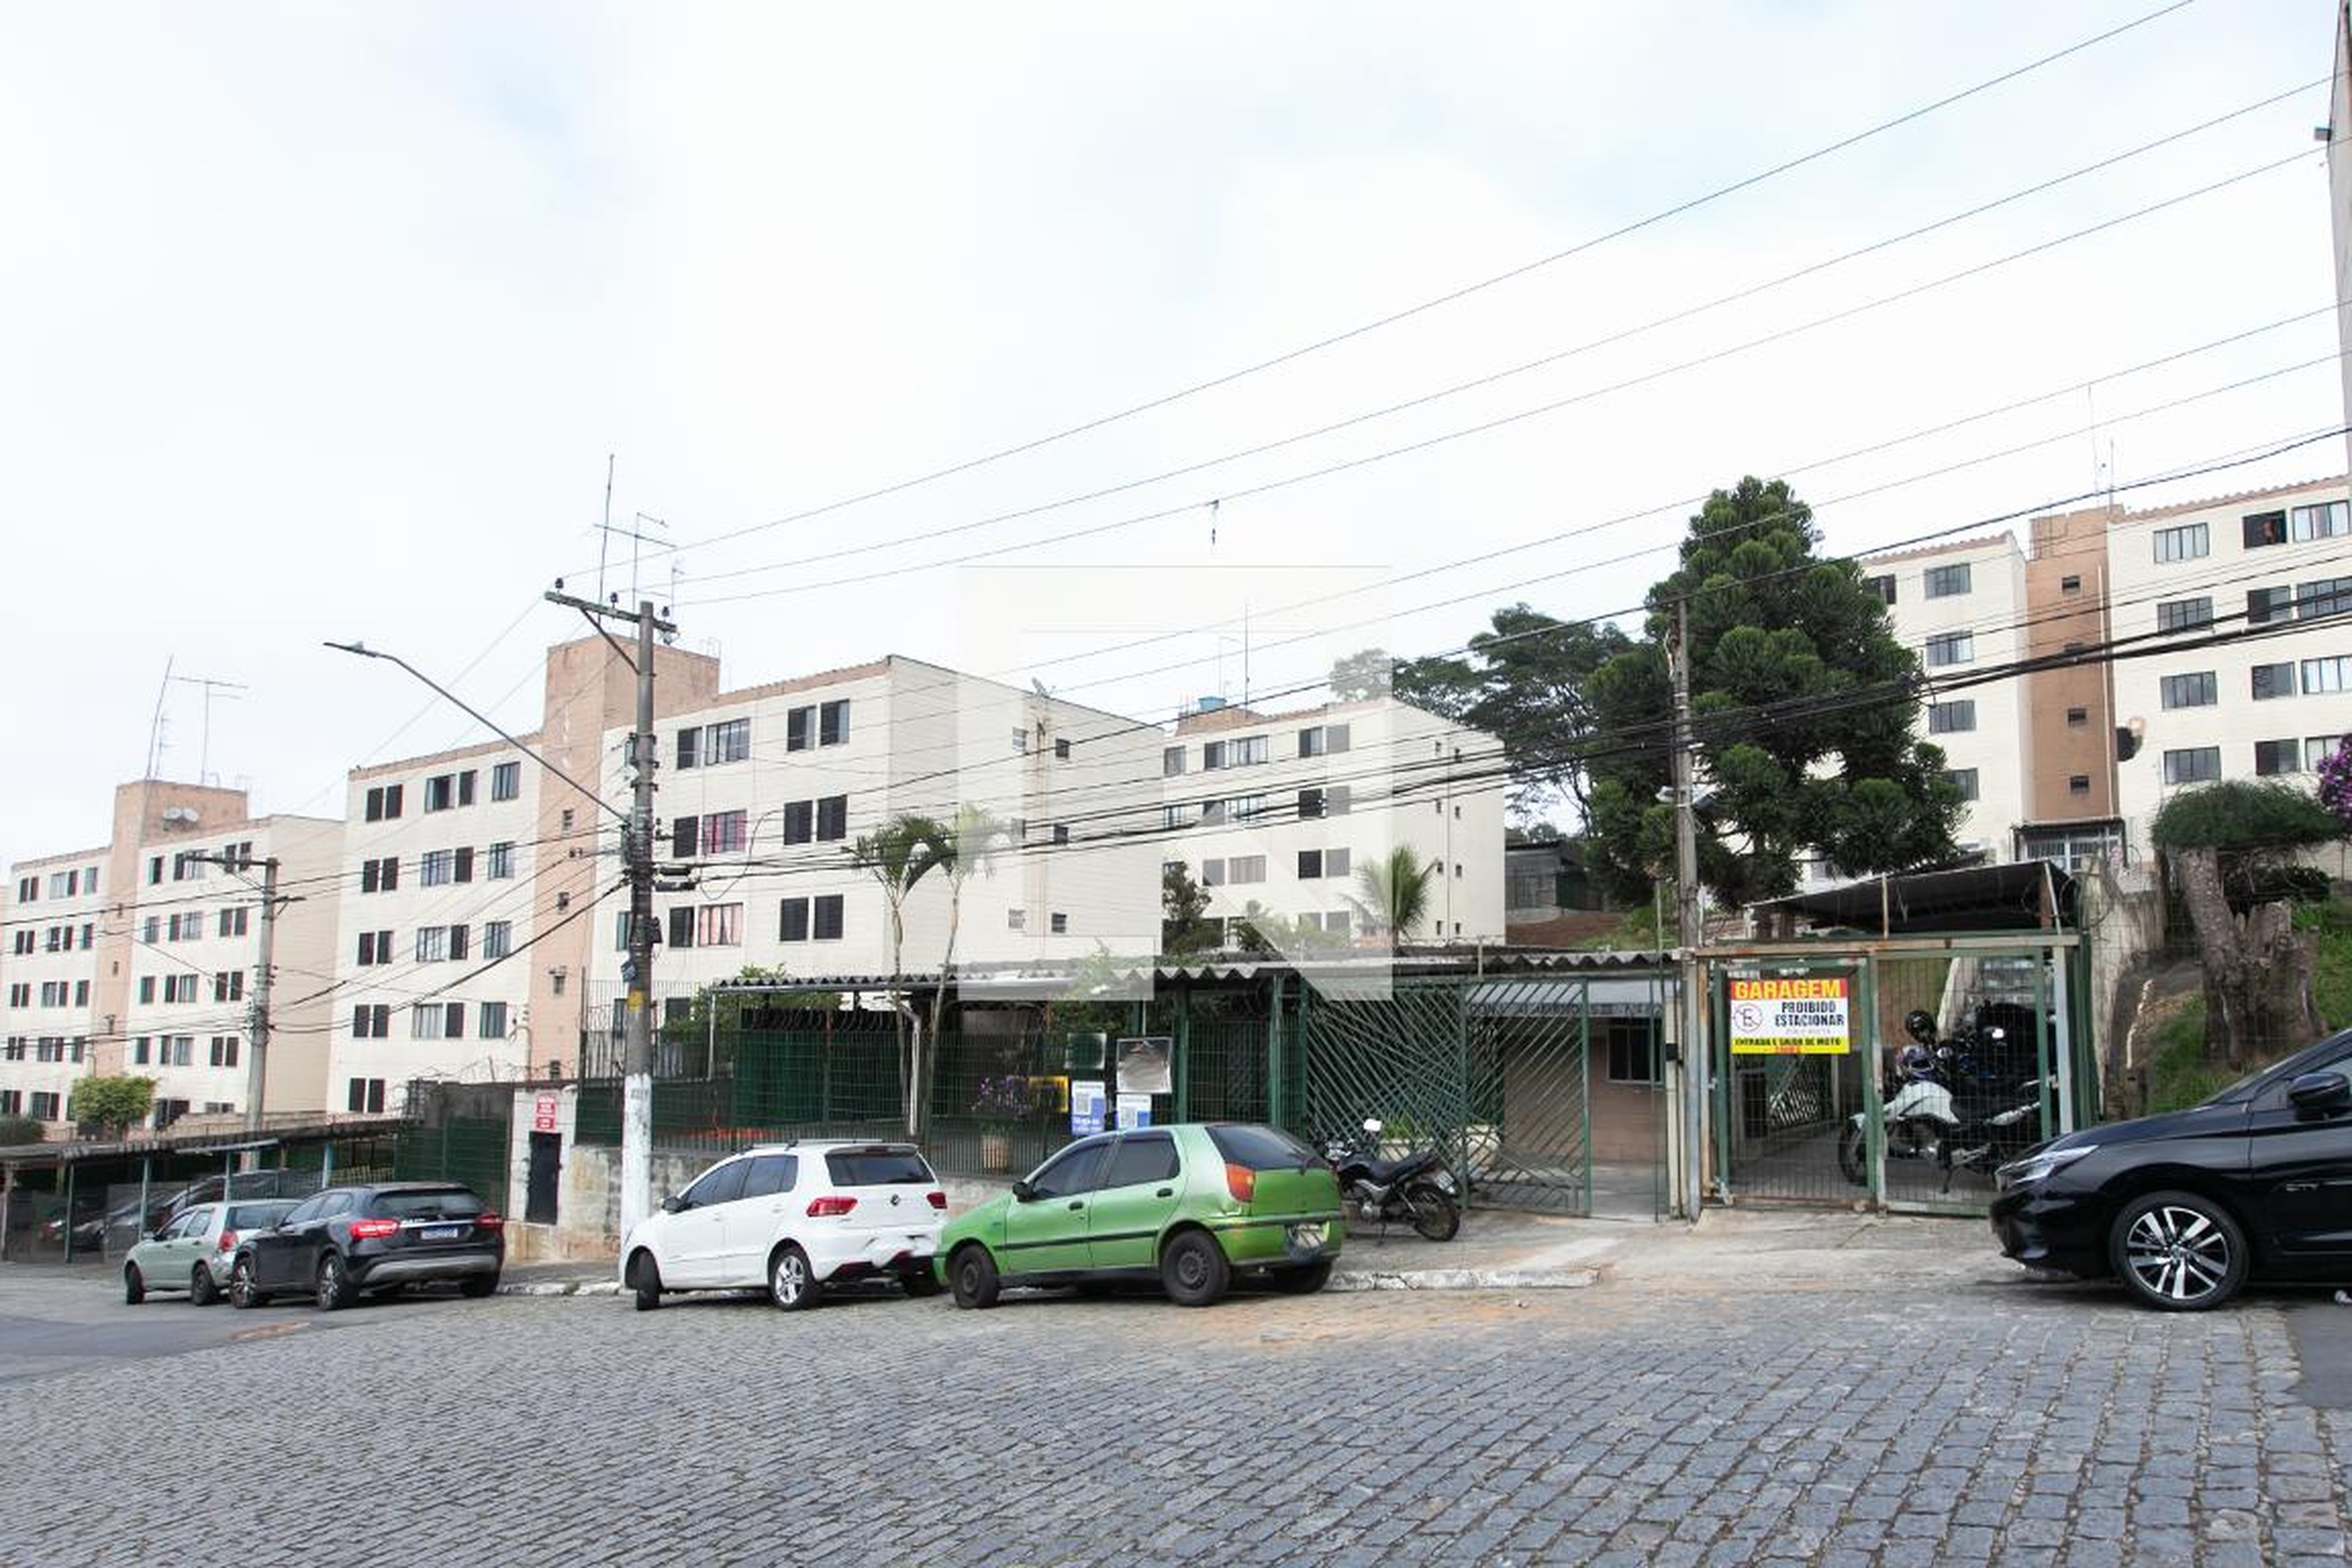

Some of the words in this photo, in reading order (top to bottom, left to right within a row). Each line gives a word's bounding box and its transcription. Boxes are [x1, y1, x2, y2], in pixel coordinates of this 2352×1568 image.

[1735, 979, 1840, 999] GARAGEM
[1782, 1001, 1836, 1013] PROIBIDO
[1776, 1014, 1844, 1027] ESTACIONAR
